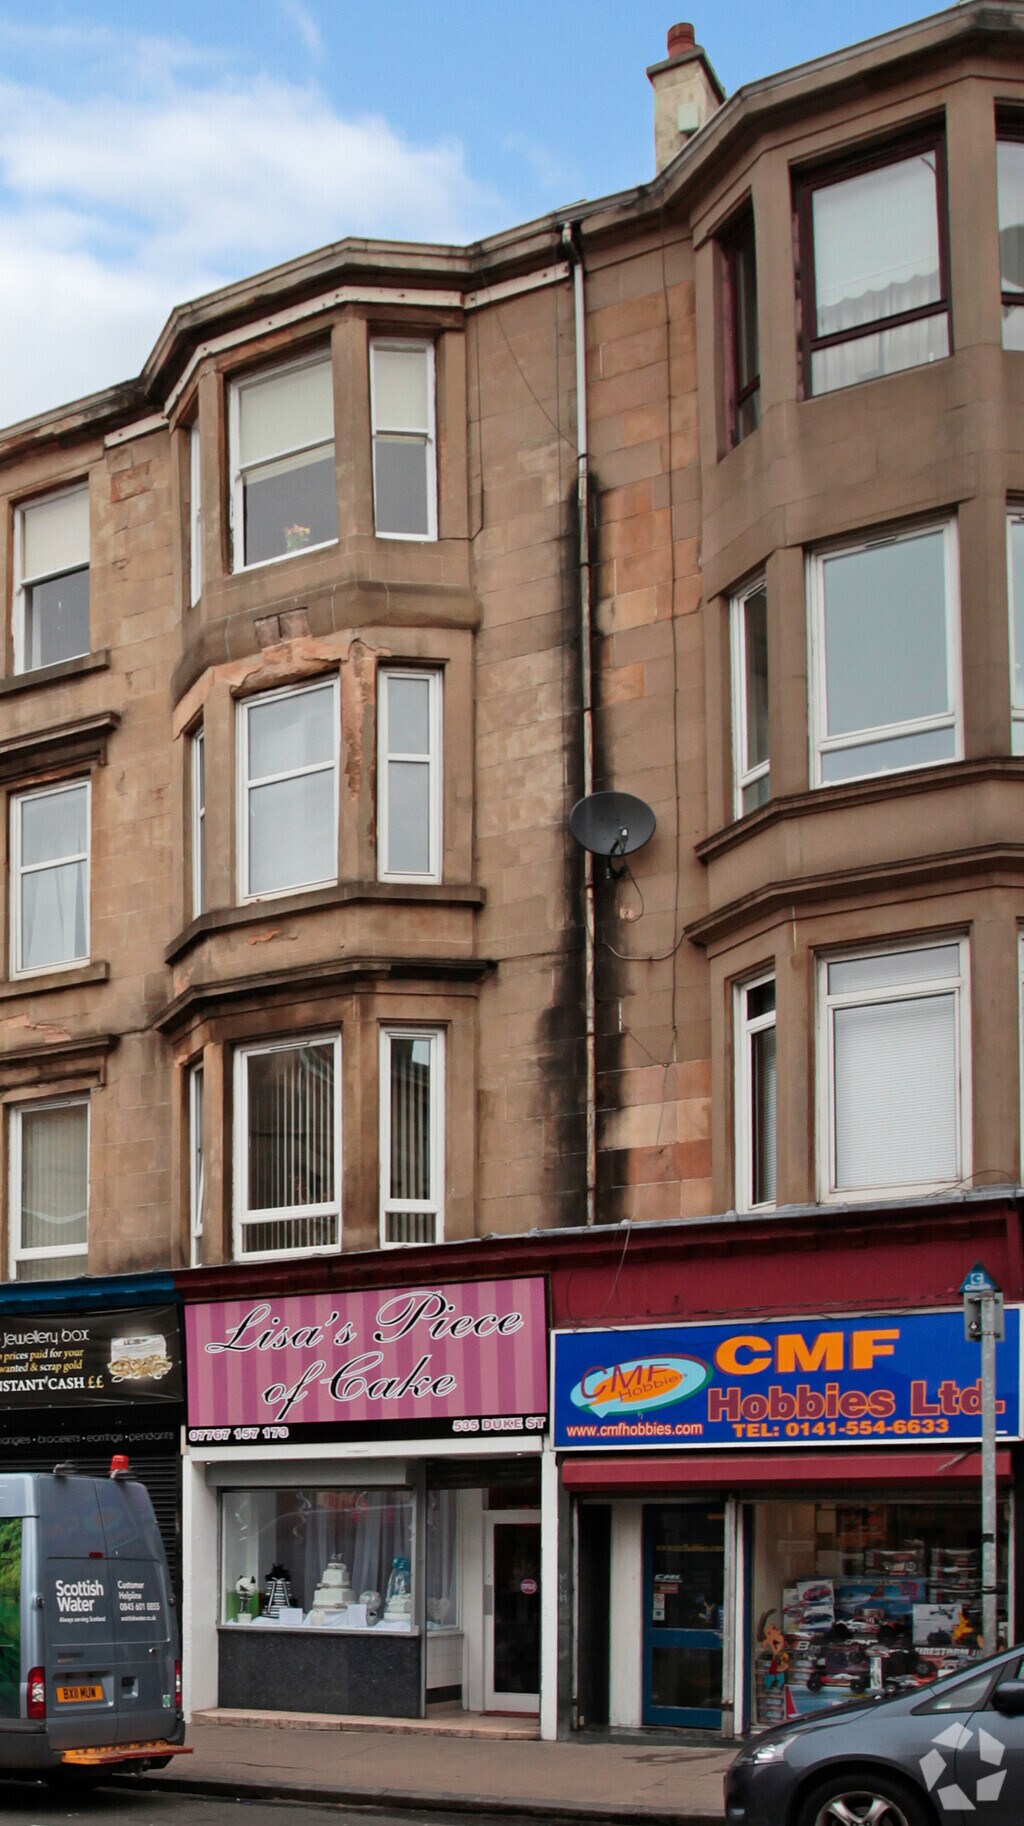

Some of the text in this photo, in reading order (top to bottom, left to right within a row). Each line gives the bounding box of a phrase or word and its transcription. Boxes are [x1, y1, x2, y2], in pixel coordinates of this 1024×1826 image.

[204, 1290, 524, 1353] Lisa's Piece
[1, 1330, 58, 1348] jewellery
[61, 1329, 90, 1342] box
[3, 1351, 28, 1363] prices
[29, 1348, 48, 1361] paid
[49, 1348, 63, 1358] for
[63, 1349, 84, 1359] your
[713, 1328, 900, 1376] CMF
[30, 1363, 38, 1371] &
[39, 1363, 62, 1373] scrap
[63, 1360, 82, 1373] gold
[48, 1377, 85, 1390] CASH
[88, 1375, 104, 1388] ££
[262, 1350, 457, 1421] of Cake
[581, 1364, 671, 1398] CMF
[618, 1372, 688, 1401] Hobbies
[708, 1382, 896, 1422] Hobbies
[452, 1416, 546, 1432] 535 DUKE ST
[566, 1422, 703, 1437] www.cmfhobbies.com
[732, 1419, 949, 1438] TEL: 0141-554-6633
[188, 1426, 289, 1441] 07767 157 173
[56, 1580, 104, 1596] Scottish
[117, 1581, 144, 1589] Customer
[119, 1591, 142, 1601] Helpline
[57, 1597, 95, 1612] Water
